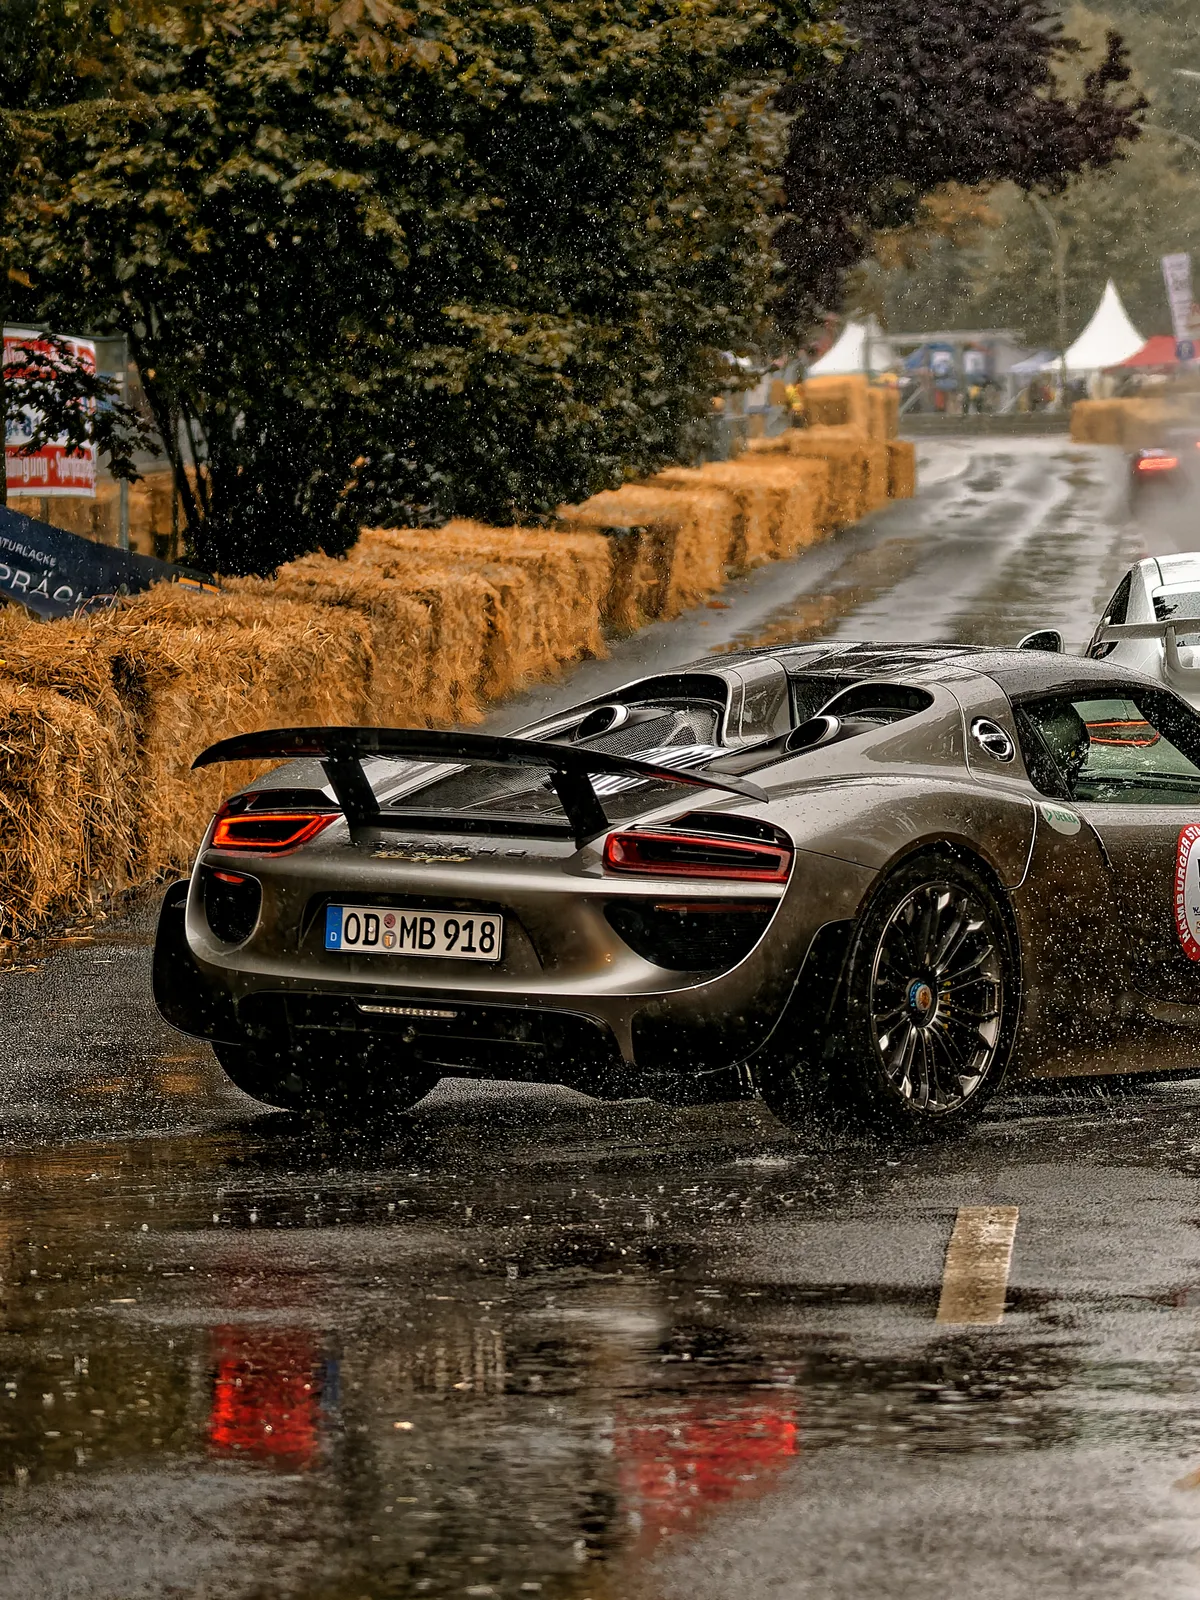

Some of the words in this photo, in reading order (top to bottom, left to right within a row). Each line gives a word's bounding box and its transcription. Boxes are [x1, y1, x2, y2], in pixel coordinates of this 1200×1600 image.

[1176, 838, 1191, 943] HAMBURGER
[344, 912, 380, 946] OD
[399, 915, 436, 950] MB
[443, 918, 496, 954] 918
